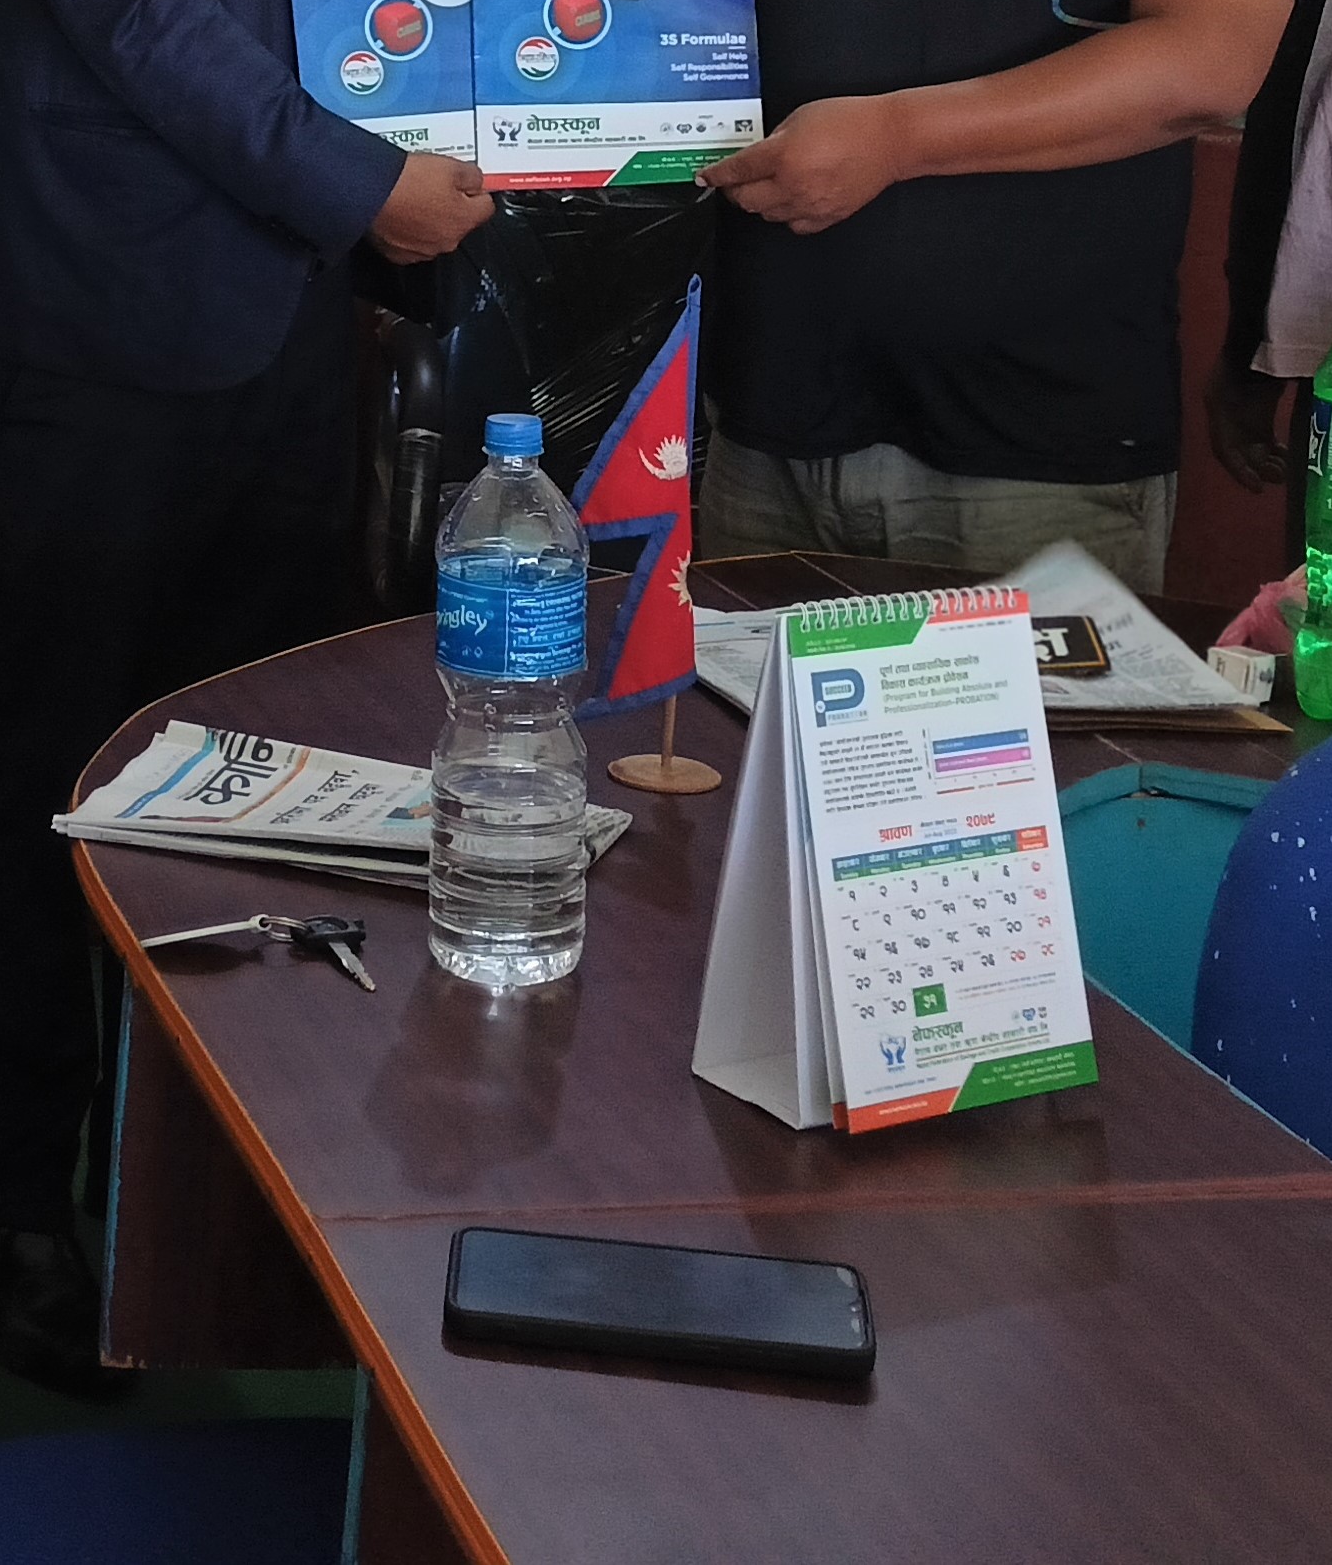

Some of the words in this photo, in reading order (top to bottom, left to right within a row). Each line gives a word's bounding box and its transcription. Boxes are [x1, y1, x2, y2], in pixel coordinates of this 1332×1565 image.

[660, 33, 678, 46] 3S
[681, 32, 747, 45] Formulae
[436, 604, 488, 636] ringley
